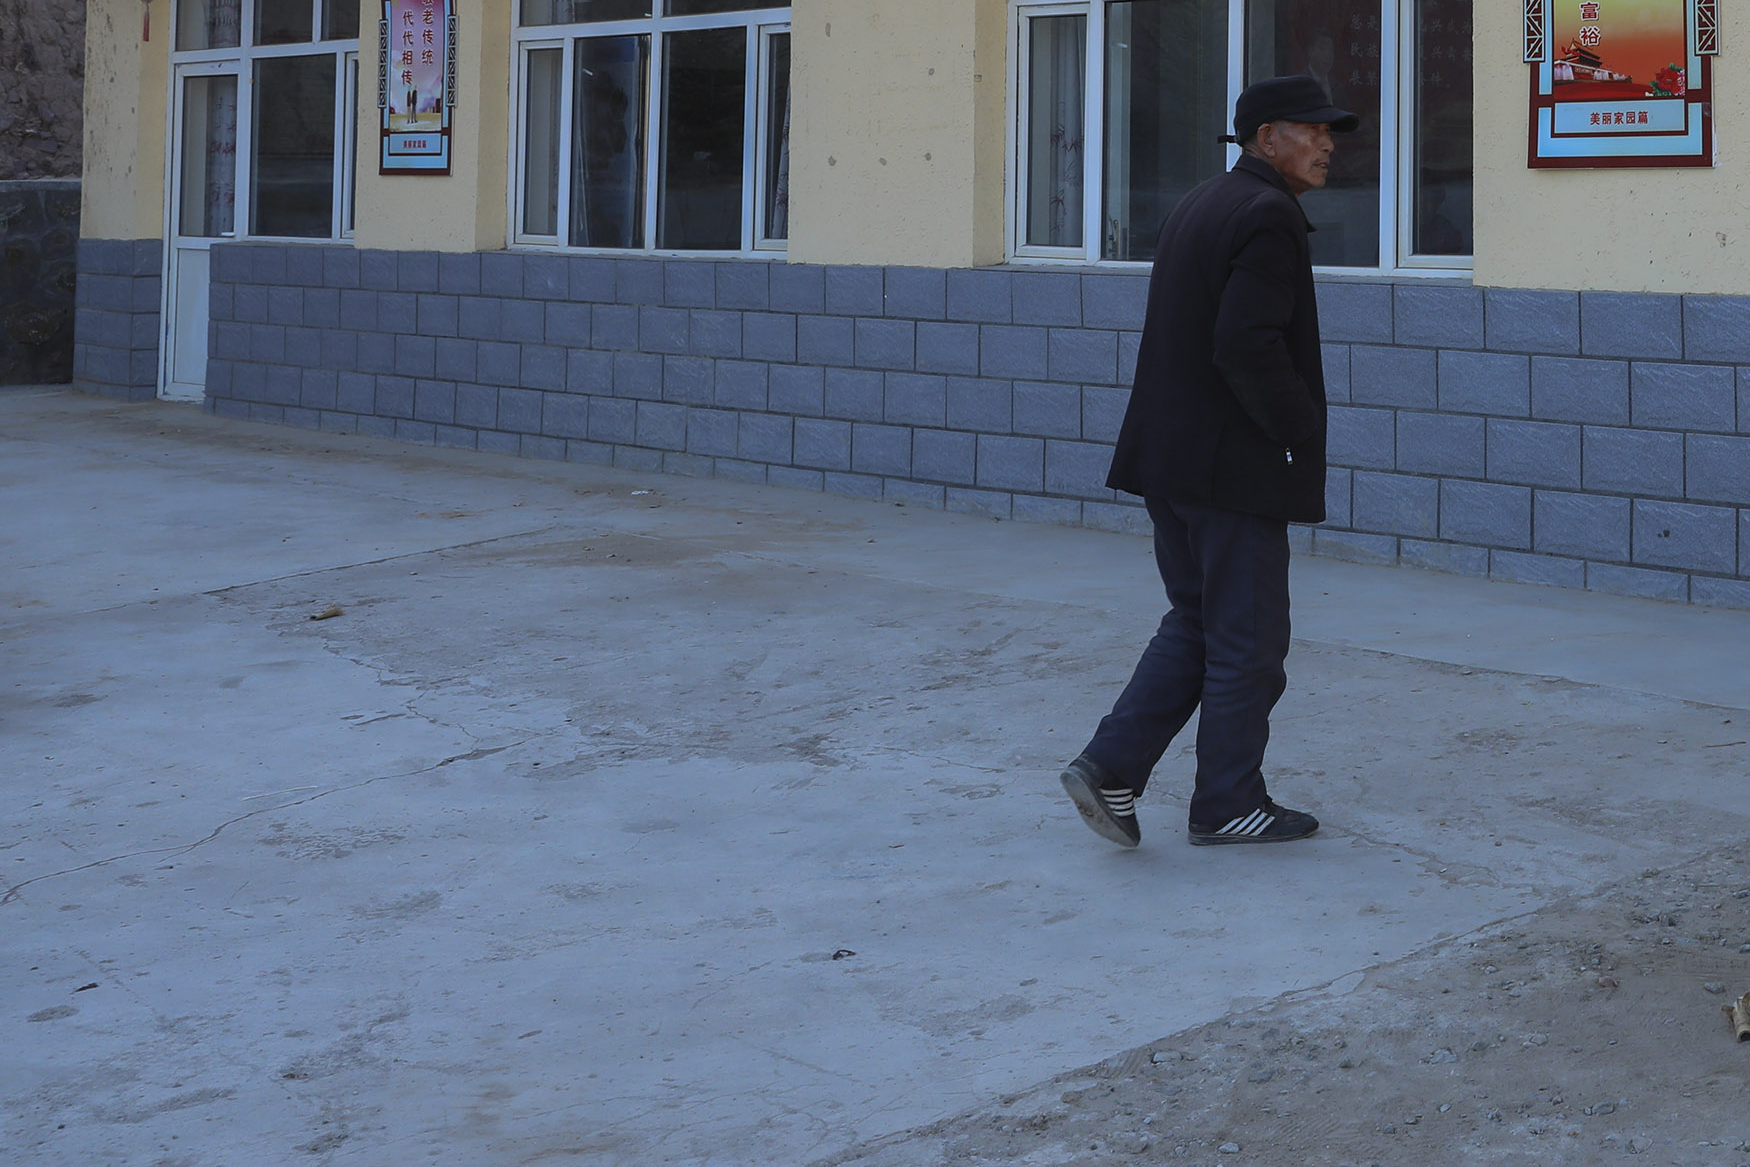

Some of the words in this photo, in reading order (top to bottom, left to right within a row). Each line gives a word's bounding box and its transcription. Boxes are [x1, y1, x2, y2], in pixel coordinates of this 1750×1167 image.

[401, 10, 414, 85] 代代相传
[1589, 110, 1649, 126] 美丽家园篇
